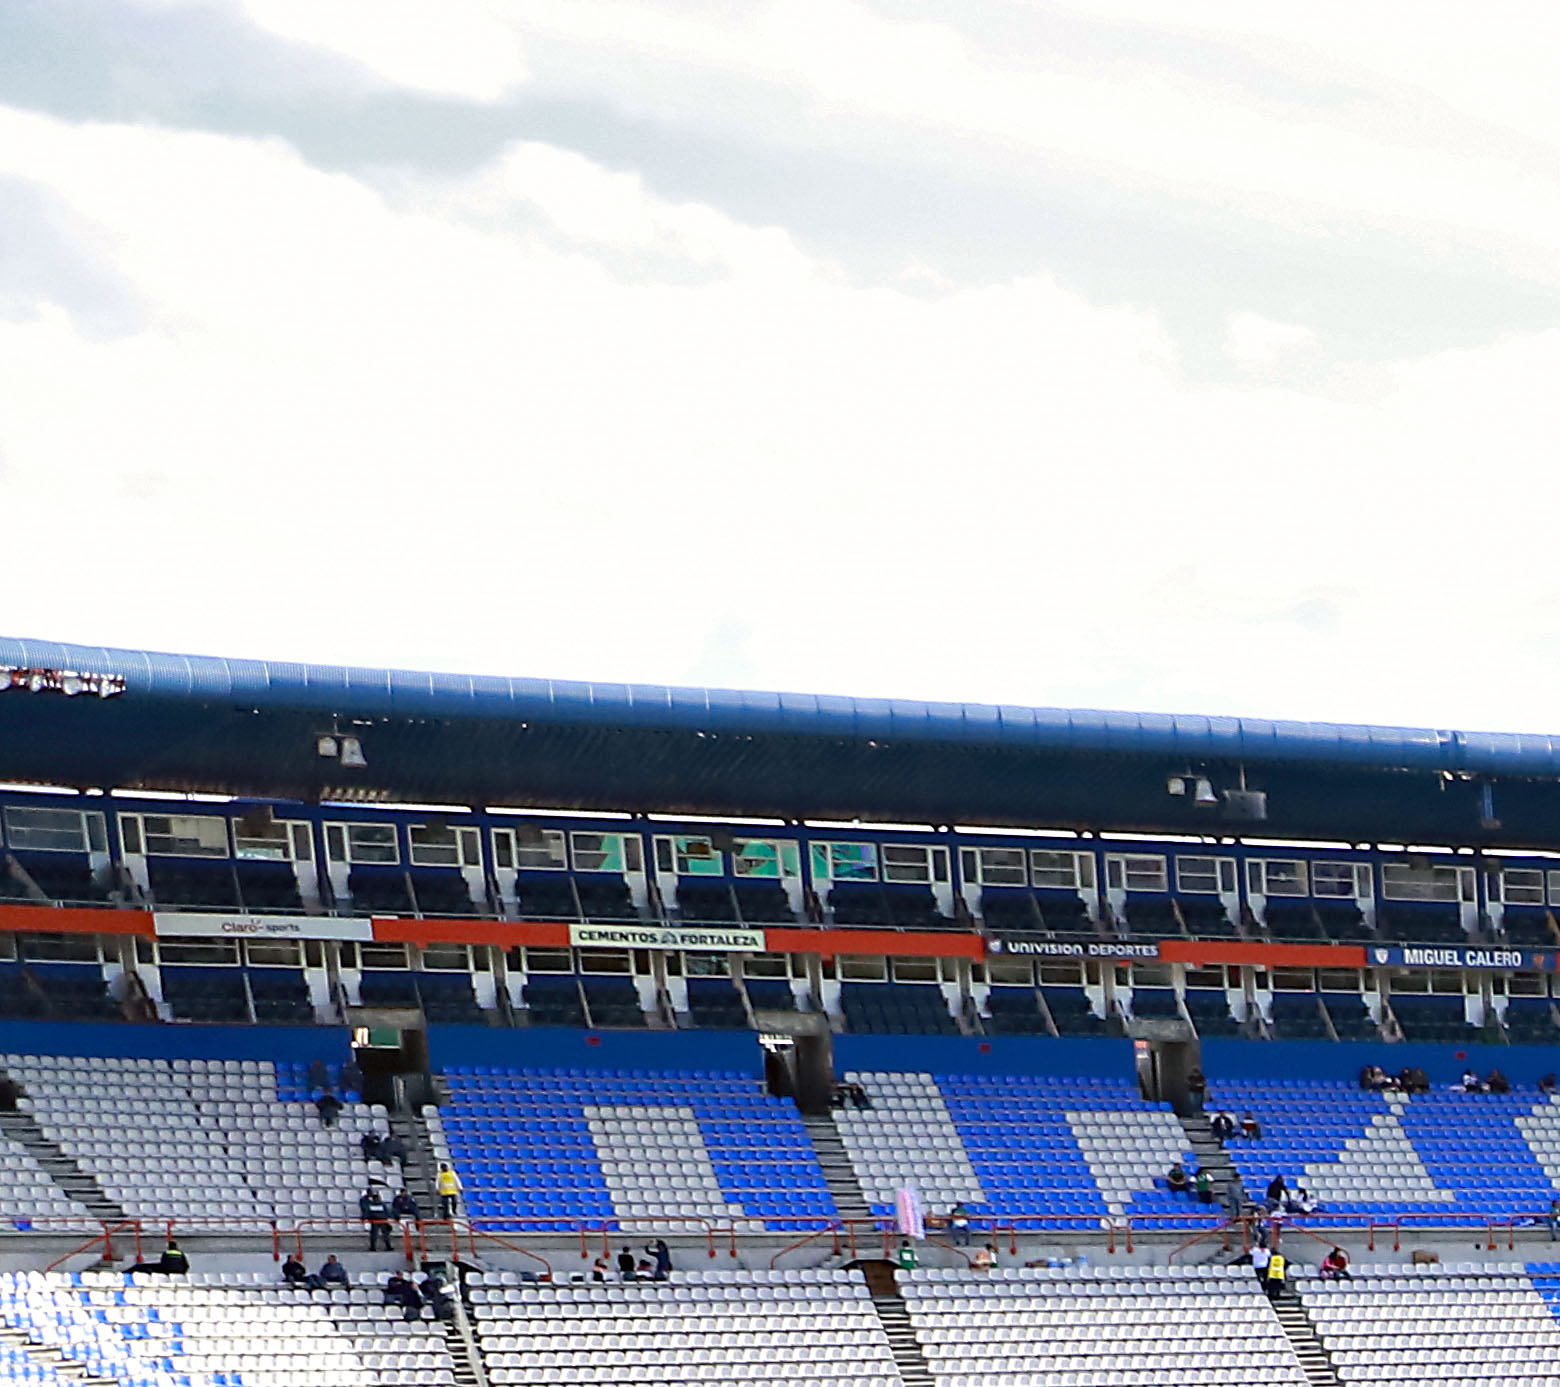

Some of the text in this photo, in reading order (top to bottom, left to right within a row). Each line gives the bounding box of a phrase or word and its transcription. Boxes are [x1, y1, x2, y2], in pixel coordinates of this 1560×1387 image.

[265, 922, 301, 933] sports
[578, 930, 759, 947] CEMENTOS FORTALEZA
[1088, 944, 1159, 957] DEPORTES
[1404, 949, 1522, 967] MIGUEL CALERO
